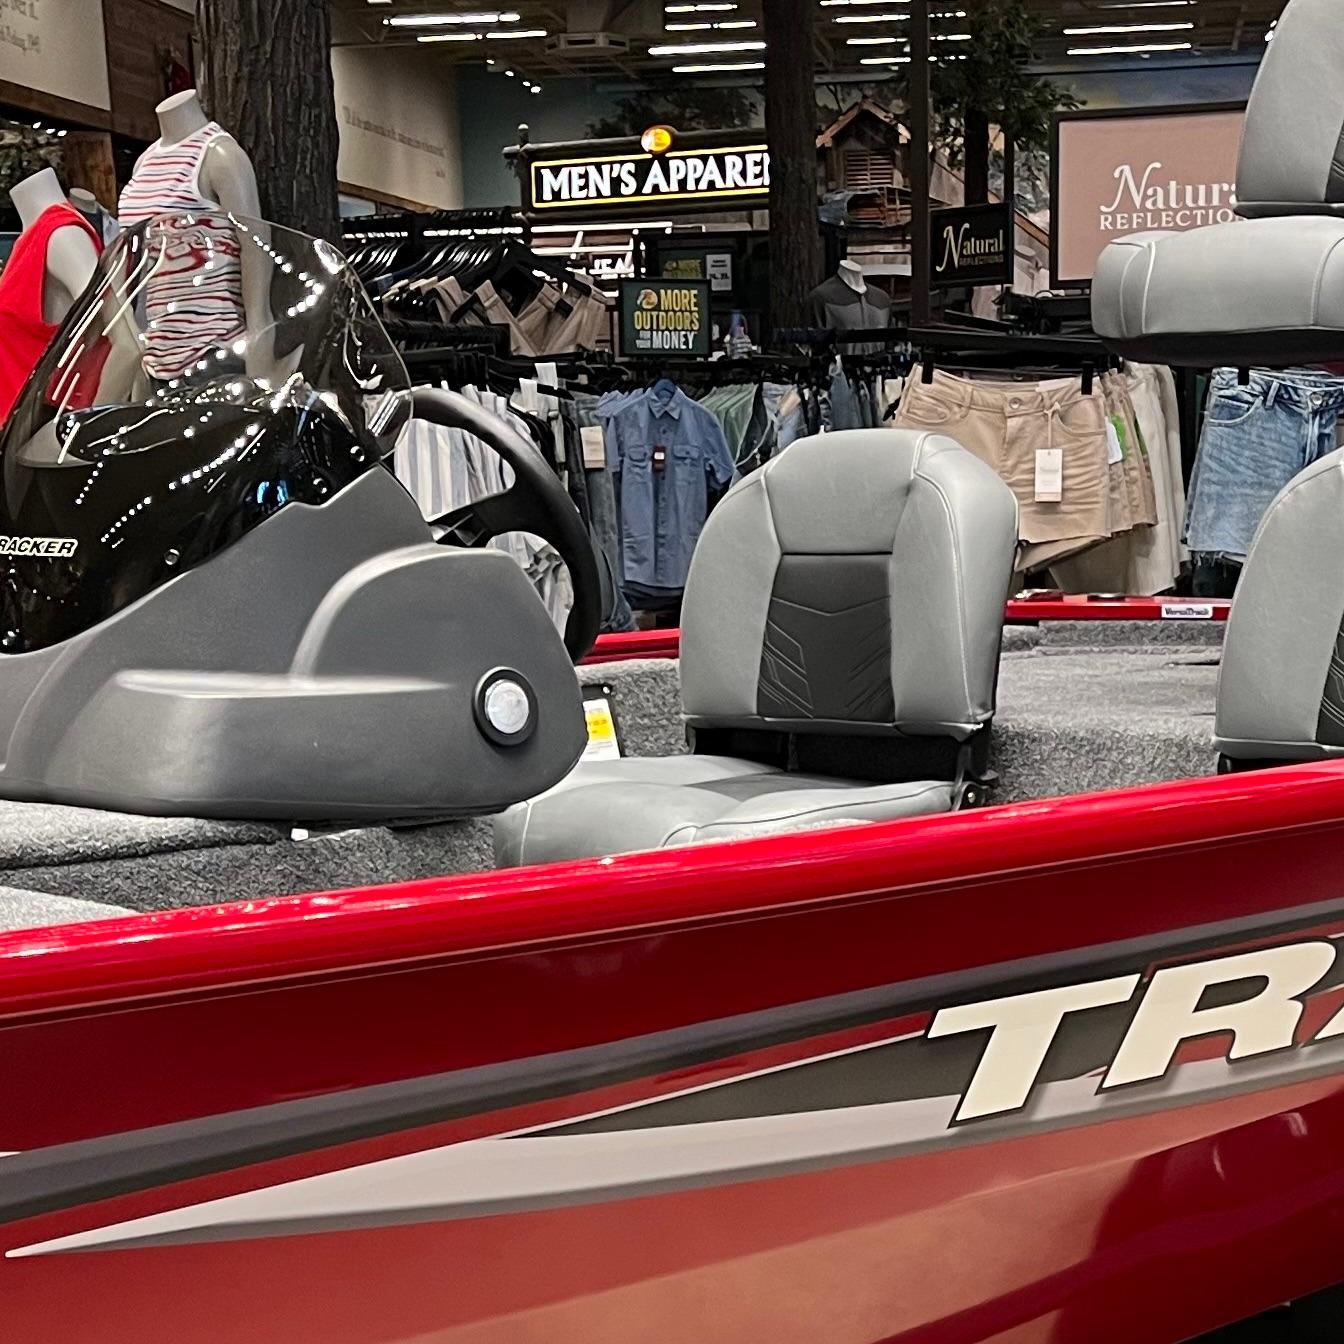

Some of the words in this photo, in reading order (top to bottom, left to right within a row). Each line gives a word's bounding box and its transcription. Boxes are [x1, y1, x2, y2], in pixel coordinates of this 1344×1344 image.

[540, 162, 638, 201] MEN'S
[1099, 162, 1237, 213] Natur
[1099, 208, 1236, 231] REFLECTIO
[936, 223, 1004, 272] Natural
[660, 289, 698, 311] MORE
[634, 311, 699, 330] OUTDOORS
[652, 331, 694, 349] MONEY
